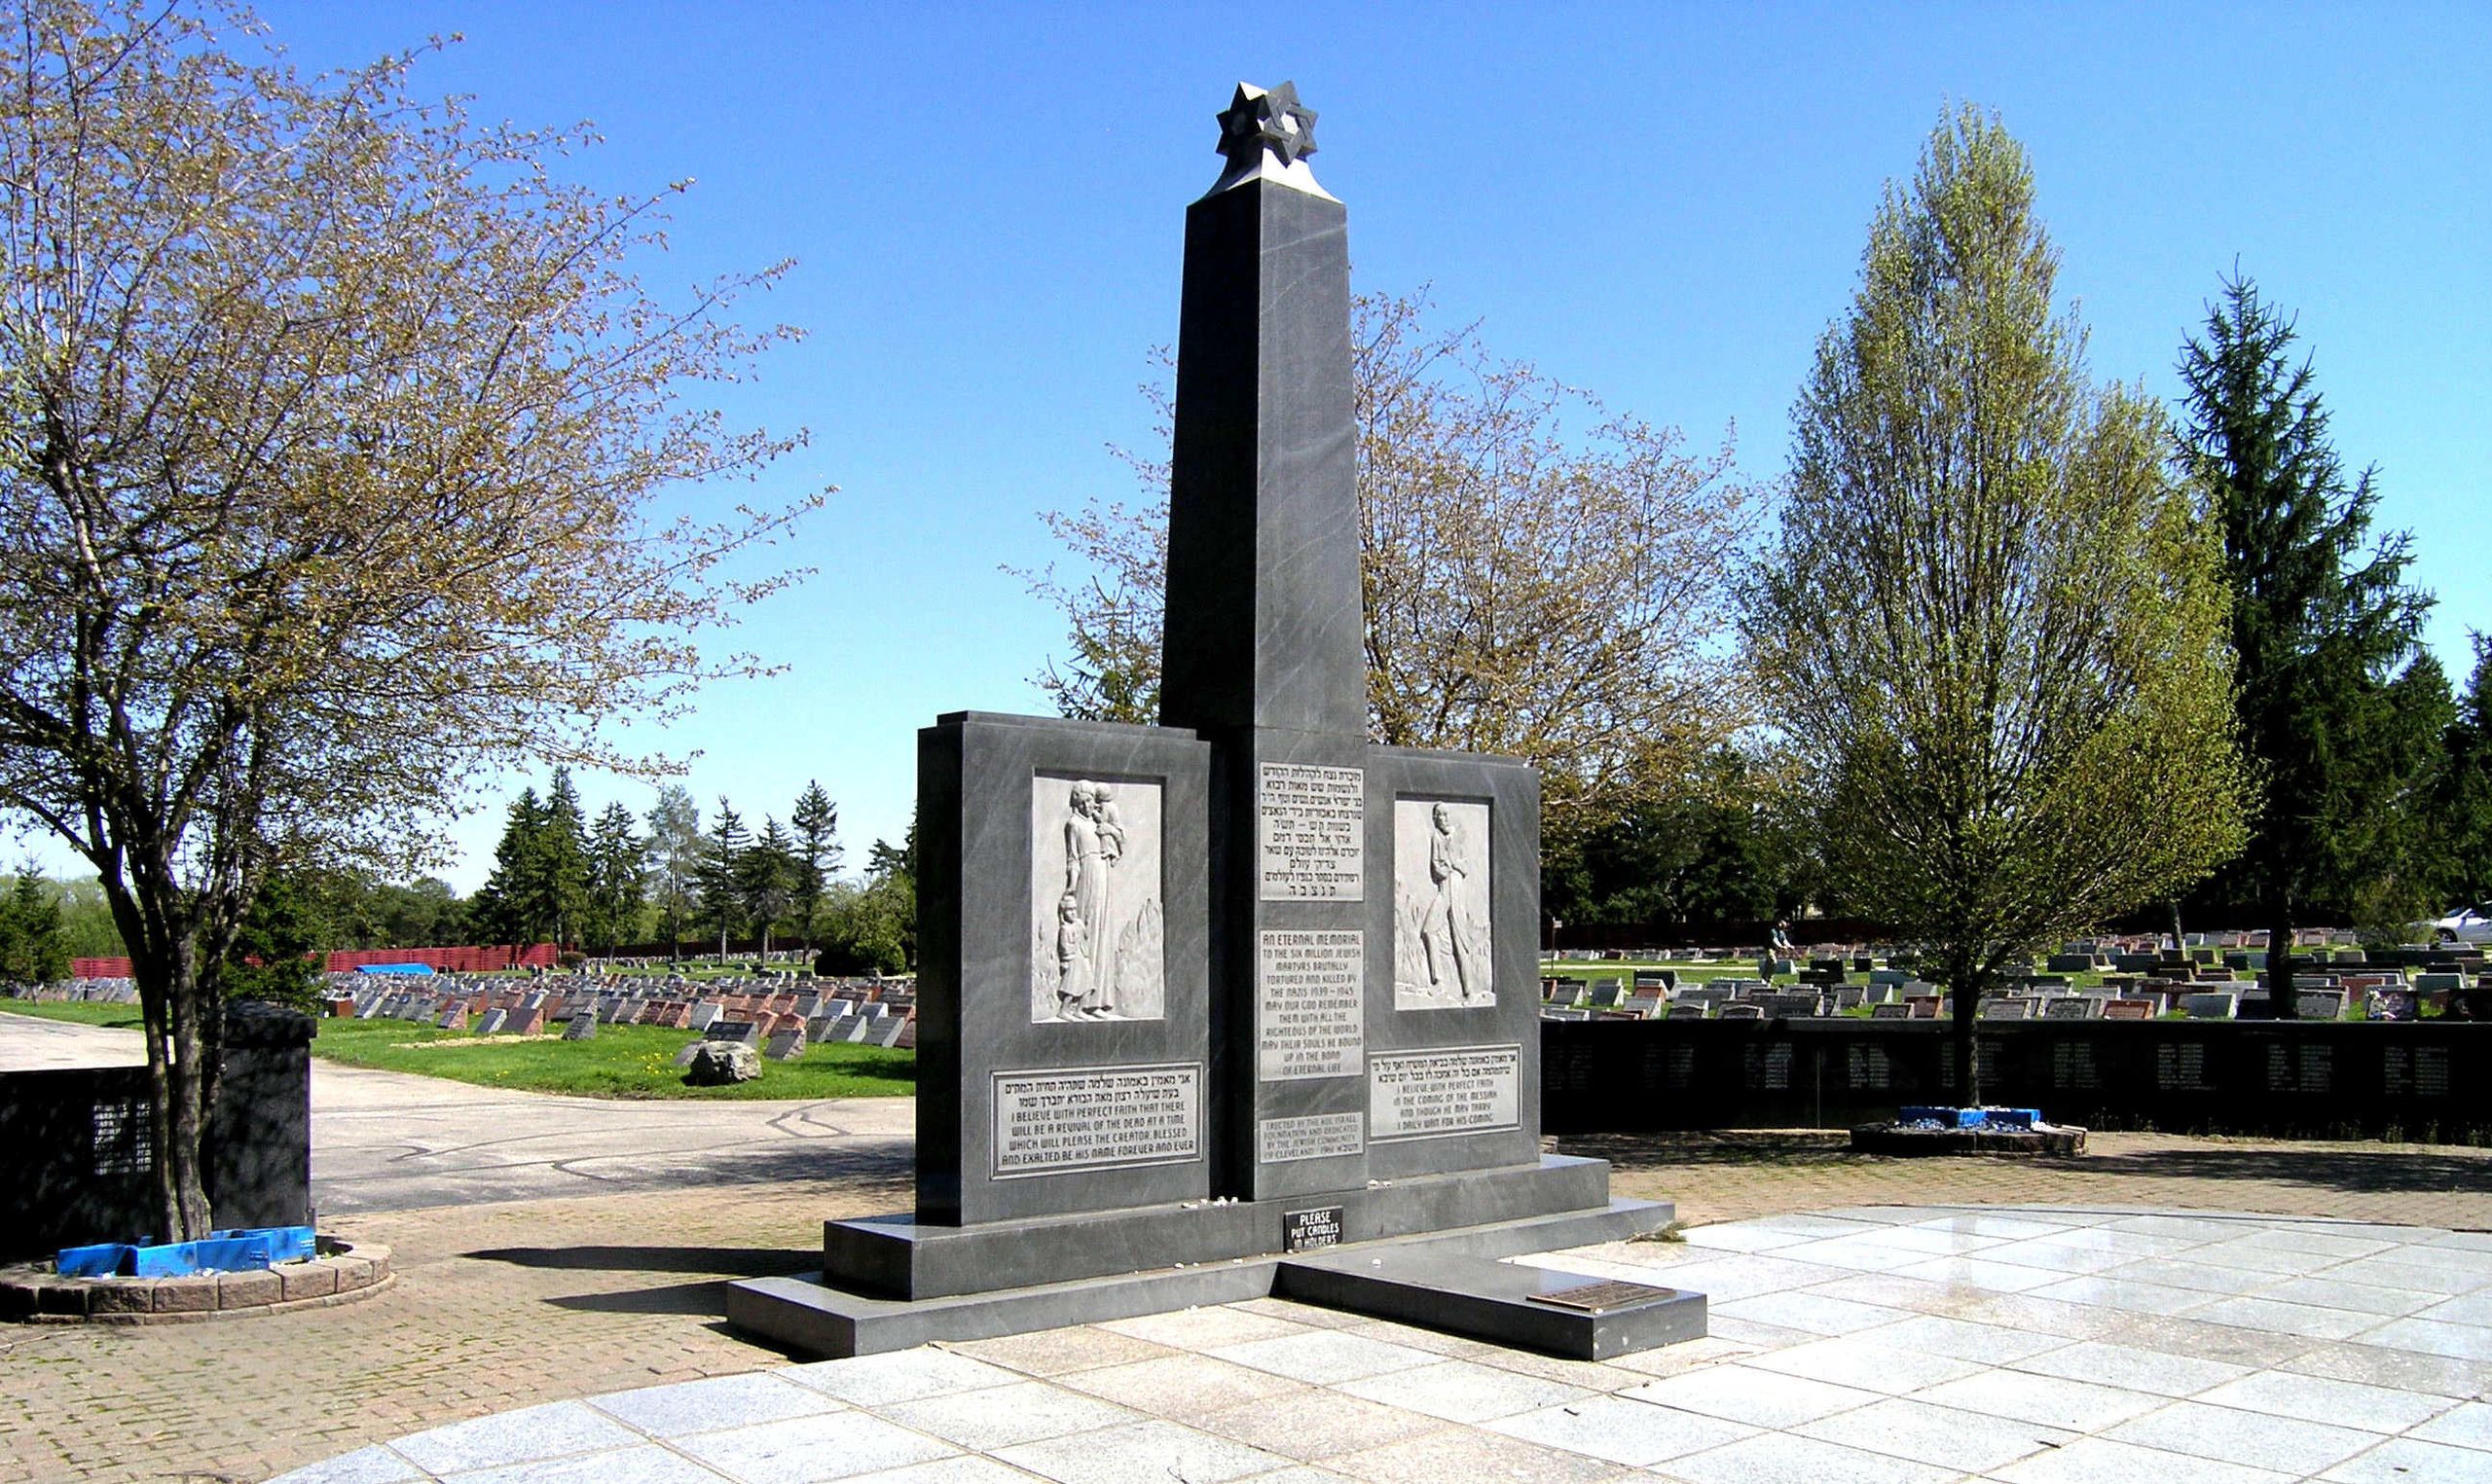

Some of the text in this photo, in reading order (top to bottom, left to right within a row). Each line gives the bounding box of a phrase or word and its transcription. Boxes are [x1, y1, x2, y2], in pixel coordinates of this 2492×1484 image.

[1278, 935, 1314, 946] ETERNAL
[1178, 1075, 1191, 1085] אני
[1448, 1080, 1475, 1090] PERFECT
[1404, 1097, 1414, 1105] THE
[1456, 1093, 1468, 1102] THE
[1016, 1110, 1050, 1122] BELIEVE
[1053, 1108, 1075, 1119] WITH
[1077, 1106, 1113, 1118] PERFECT
[1115, 1104, 1137, 1115] FAITH
[1139, 1104, 1158, 1114] THAT
[1161, 1102, 1185, 1112] THERE
[1011, 1115, 1185, 1137] WILL BE A REVIVAL OF THE DEAD AT A TIME
[1009, 1139, 1039, 1151] WHICH
[1041, 1138, 1060, 1148] WILL
[1062, 1135, 1092, 1147] PLEASE
[1096, 1134, 1110, 1144] THE
[1154, 1128, 1187, 1140] BLESSED
[1002, 1140, 1193, 1166] AND EXALTED BE HIS NAME FOREVER AND EVER
[1301, 1213, 1331, 1225] PLEASE
[1292, 1223, 1338, 1238] PUT CANDLES
[1305, 1235, 1337, 1247] HOLDERS
